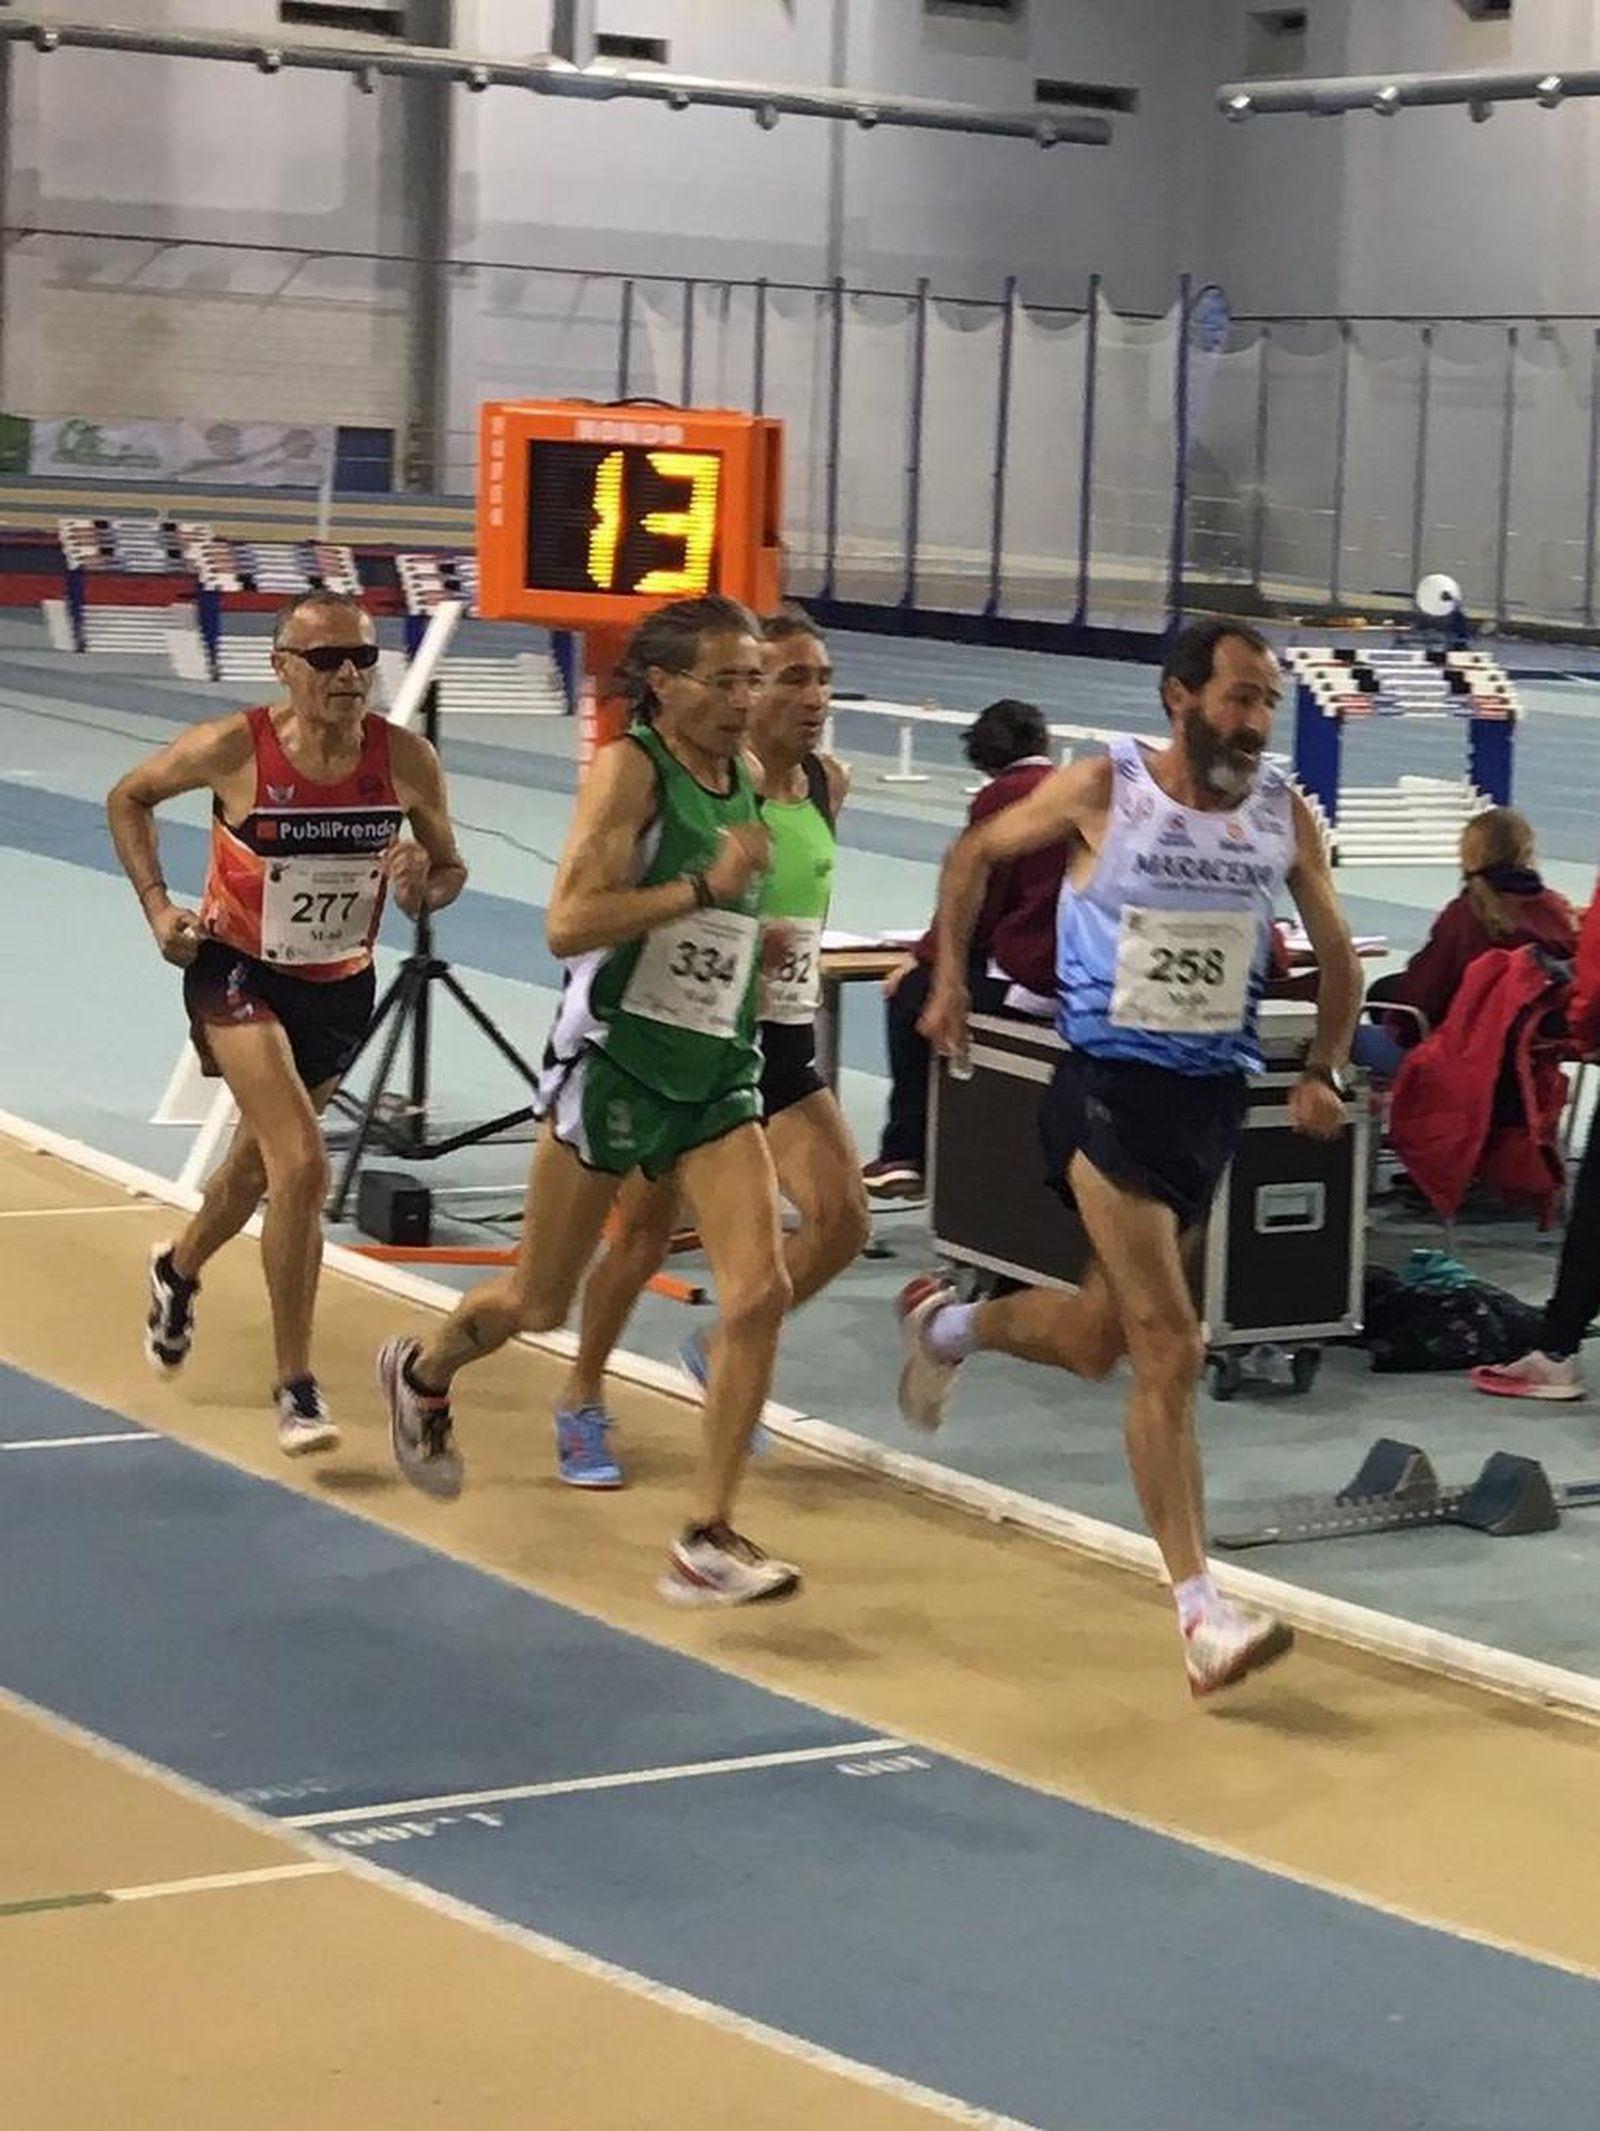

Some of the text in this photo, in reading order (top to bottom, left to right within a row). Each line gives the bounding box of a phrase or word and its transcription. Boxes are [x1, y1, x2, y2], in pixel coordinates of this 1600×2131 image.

[586, 450, 721, 594] 13
[290, 891, 360, 923] 277
[670, 940, 739, 983] 334
[778, 950, 812, 984] 82
[1146, 947, 1226, 985] 258
